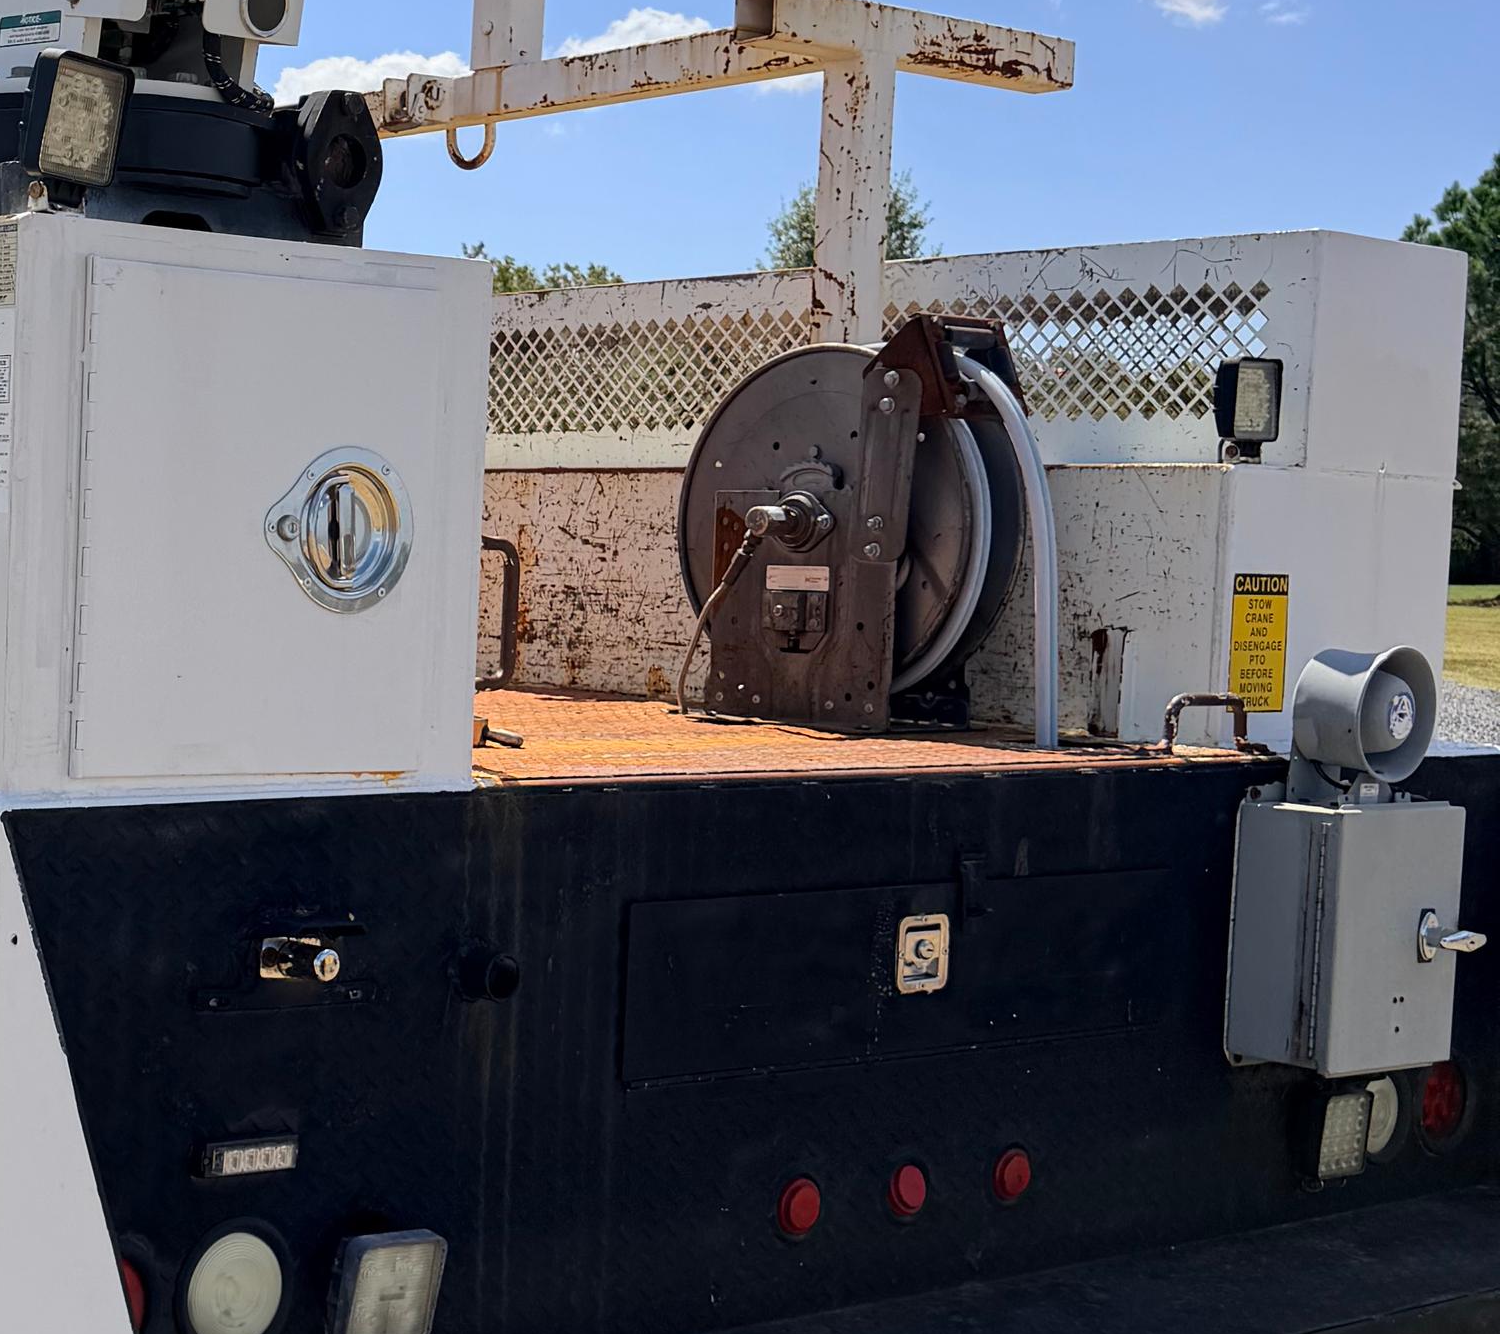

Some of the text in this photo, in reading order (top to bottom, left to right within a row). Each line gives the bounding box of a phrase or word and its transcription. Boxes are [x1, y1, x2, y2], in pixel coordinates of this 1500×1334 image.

[1235, 576, 1288, 592] CAUTION
[1248, 599, 1272, 609] STOW
[1245, 613, 1274, 623] CRANE
[1250, 627, 1268, 637] AND
[1234, 641, 1282, 651] DISENGAGE
[1249, 655, 1266, 665] PTO
[1240, 669, 1273, 679] BEFORE
[1240, 683, 1272, 693] MOVING
